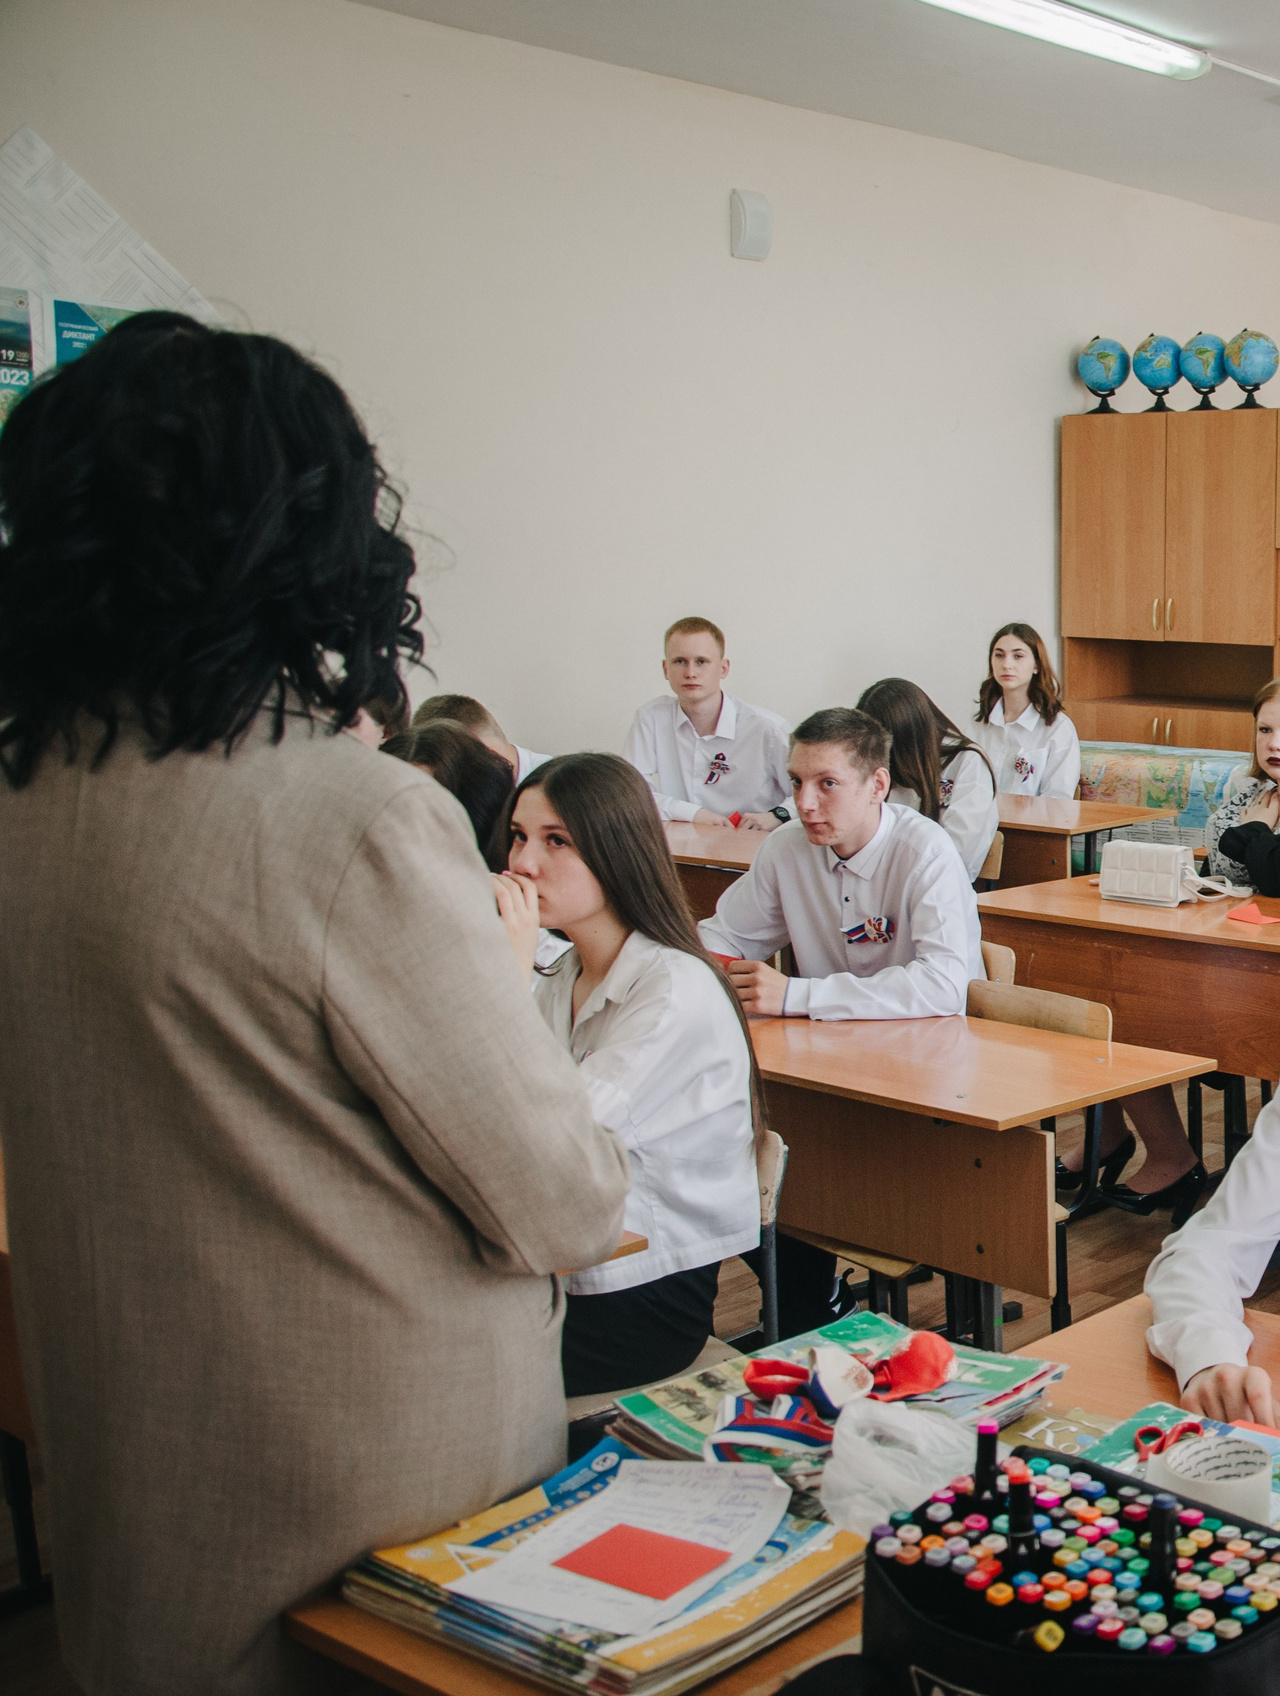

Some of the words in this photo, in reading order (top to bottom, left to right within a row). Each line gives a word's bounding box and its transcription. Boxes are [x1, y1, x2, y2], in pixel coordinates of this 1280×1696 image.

[62, 330, 95, 341] ДИКТАНТ
[1, 349, 15, 360] 19
[0, 368, 30, 386] 023
